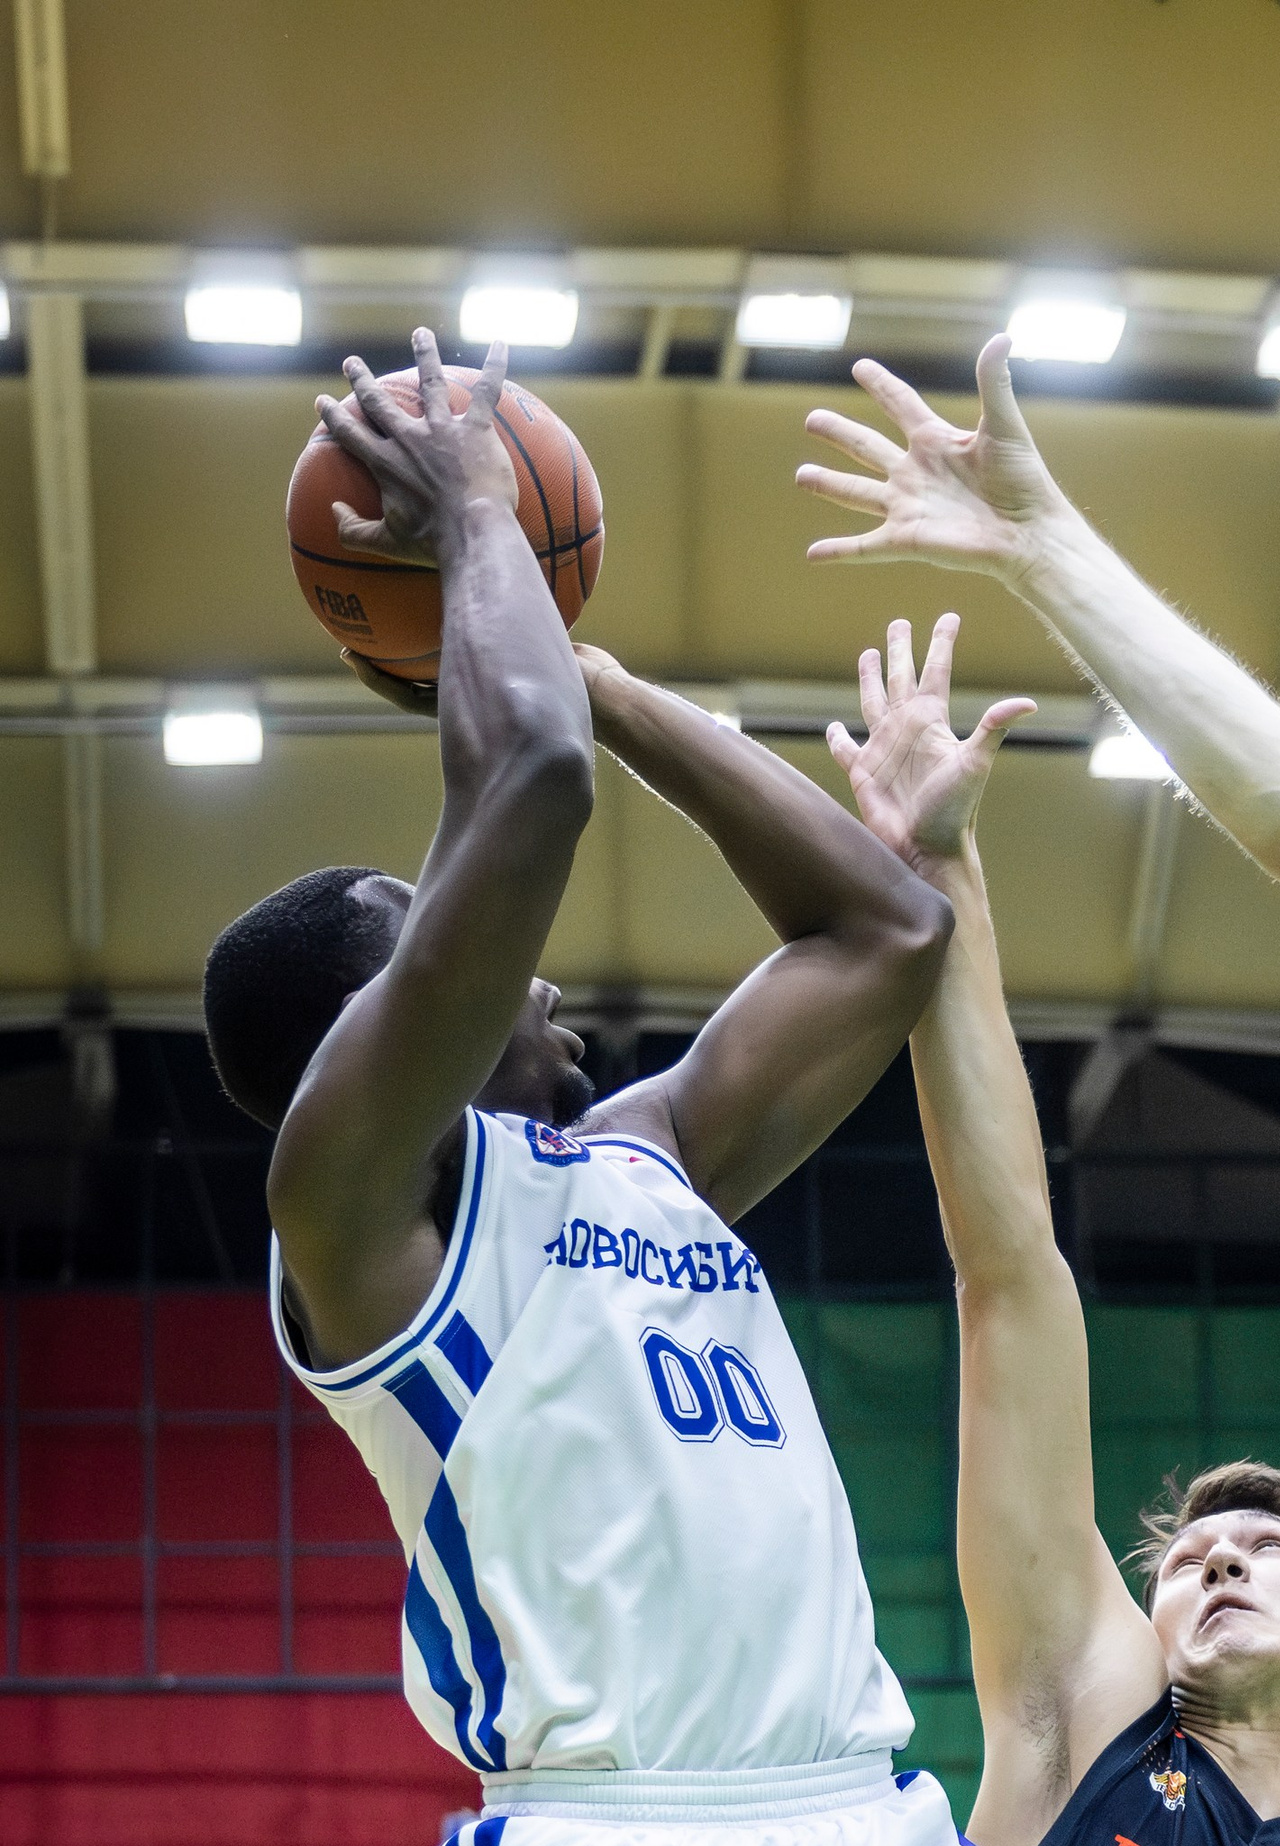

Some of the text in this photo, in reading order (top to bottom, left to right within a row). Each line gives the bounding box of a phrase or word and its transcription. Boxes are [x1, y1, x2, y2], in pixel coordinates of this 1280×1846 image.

[314, 585, 369, 622] FIBA
[543, 1217, 762, 1293] ОВОСИБИ
[639, 1326, 787, 1449] 00
